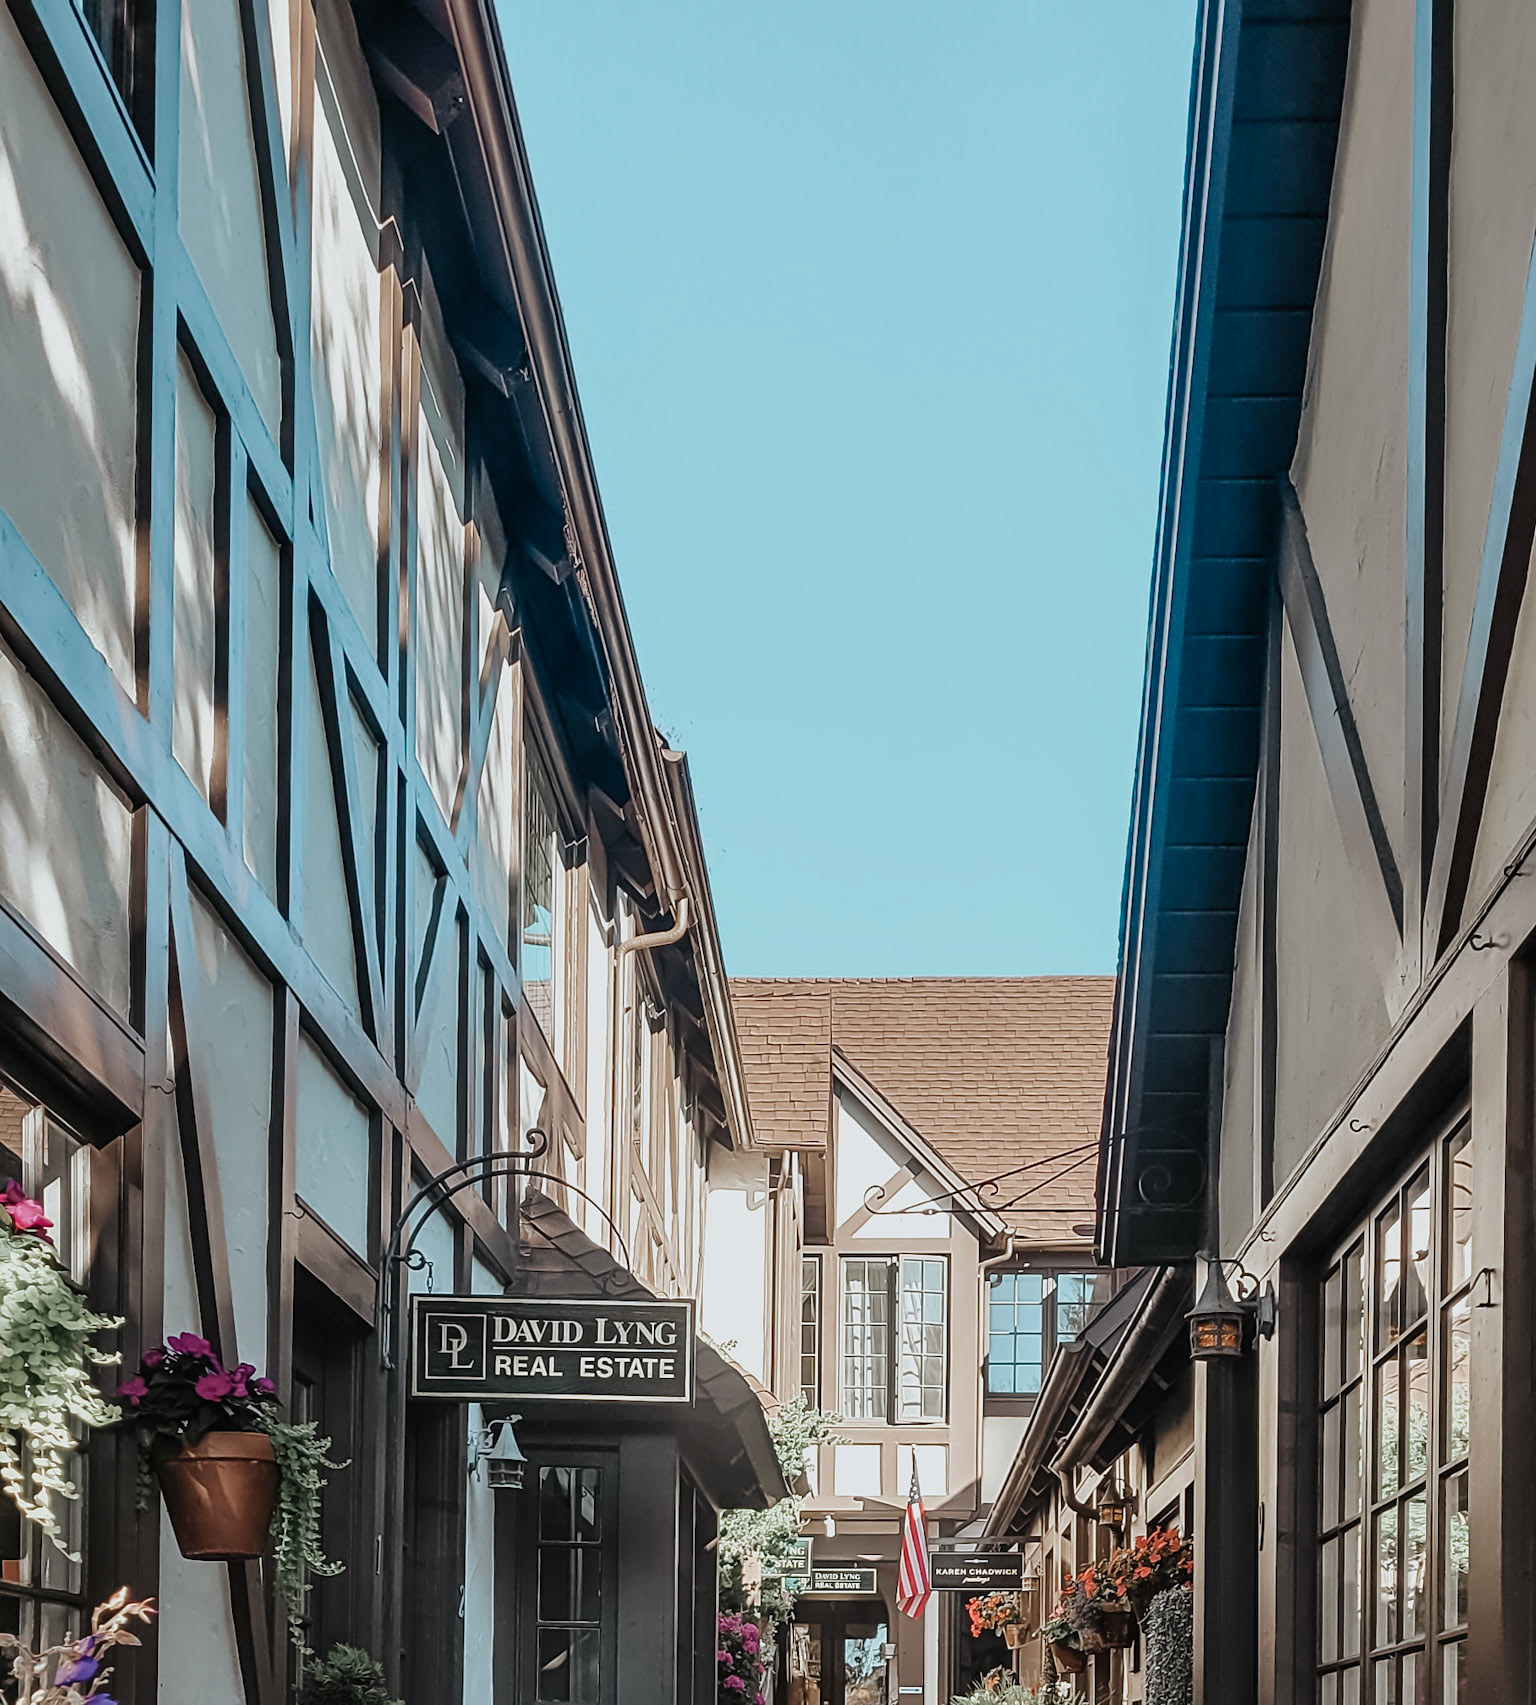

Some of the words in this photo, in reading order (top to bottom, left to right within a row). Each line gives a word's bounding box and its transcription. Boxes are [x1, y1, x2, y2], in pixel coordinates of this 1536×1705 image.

[492, 1316, 583, 1344] DAVID
[594, 1317, 678, 1345] LYNG
[437, 1322, 475, 1369] DL
[494, 1355, 563, 1377] REAL
[579, 1356, 675, 1379] ESTATE
[783, 1546, 805, 1556] NG
[774, 1560, 805, 1568] STATE
[815, 1572, 839, 1580] DAVID
[839, 1572, 861, 1580] LYNG
[935, 1568, 967, 1576] KAREN
[968, 1568, 1018, 1576] CHADWICK
